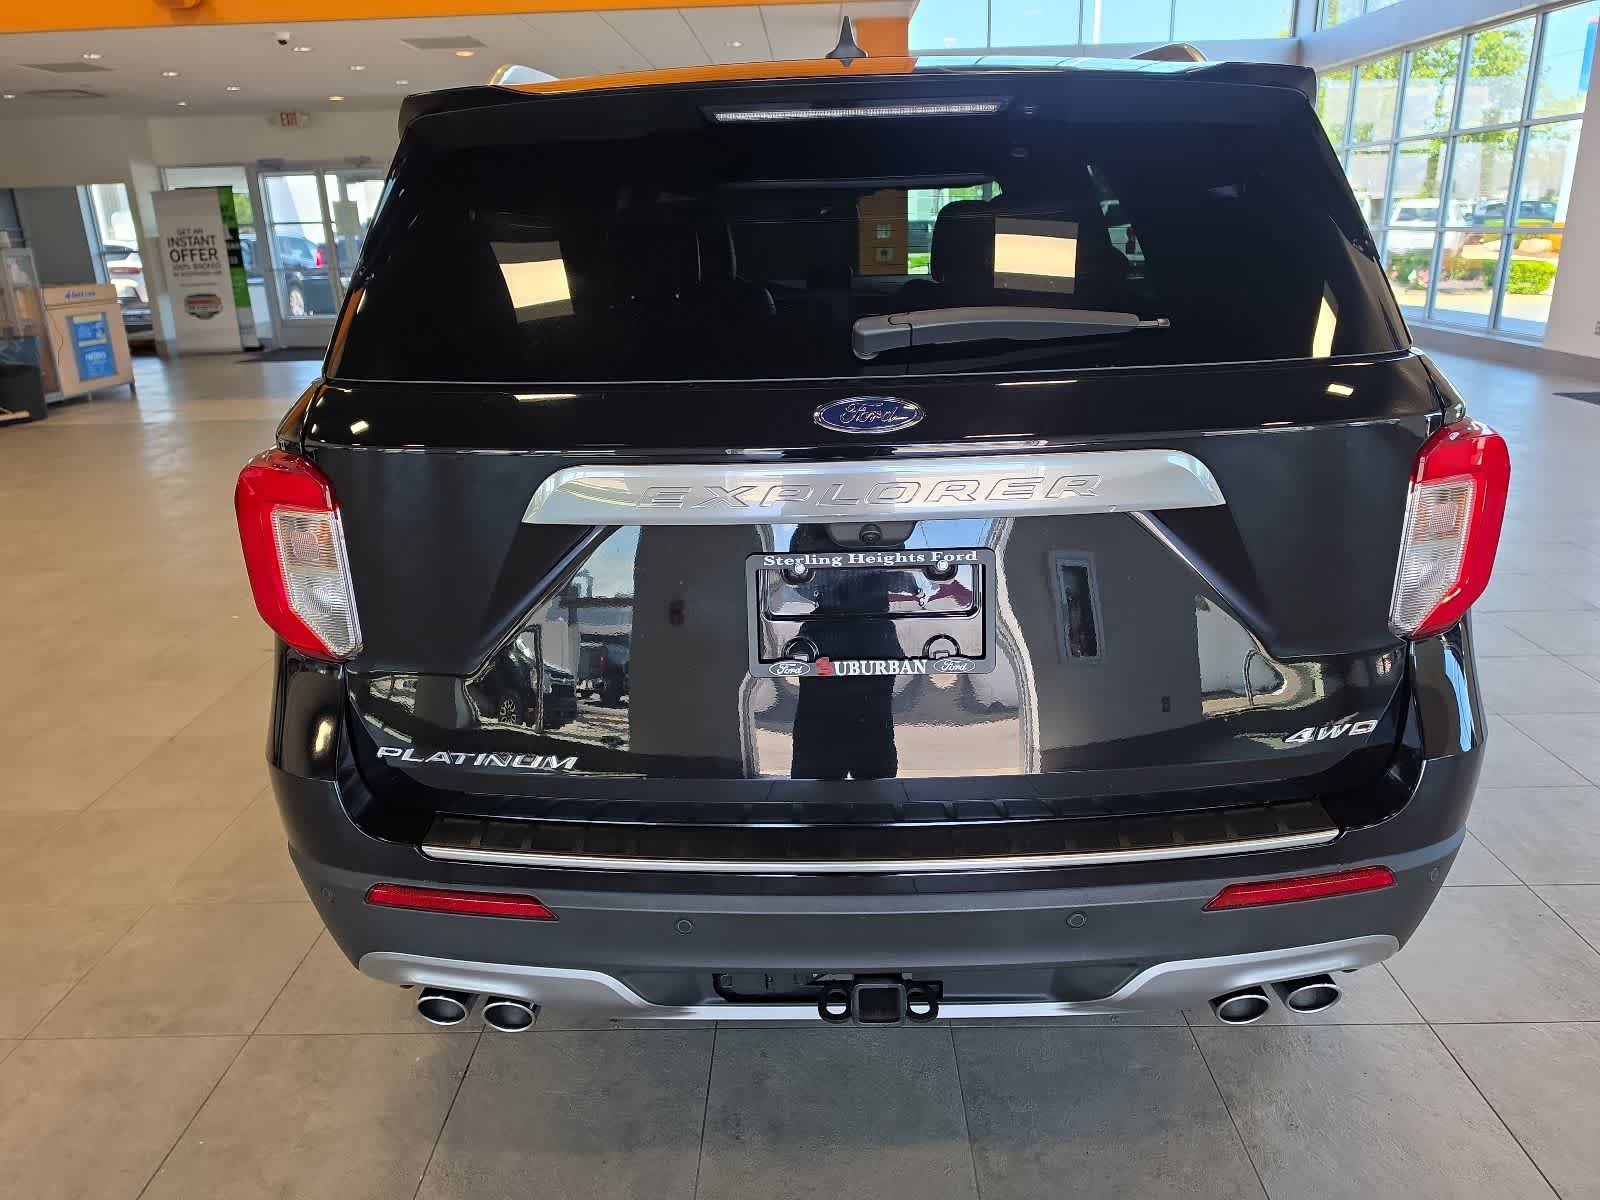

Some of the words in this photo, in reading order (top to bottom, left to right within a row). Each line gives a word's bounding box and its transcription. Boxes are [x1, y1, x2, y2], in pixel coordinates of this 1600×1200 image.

[167, 235, 216, 248] INSTANT
[169, 247, 219, 262] OFFER
[637, 474, 1103, 509] EXPLORER
[763, 555, 842, 567] Sterling
[847, 553, 925, 565] Heights
[930, 551, 978, 564] Ford
[1284, 719, 1379, 743] 4WD
[376, 746, 579, 770] PLATINUM
